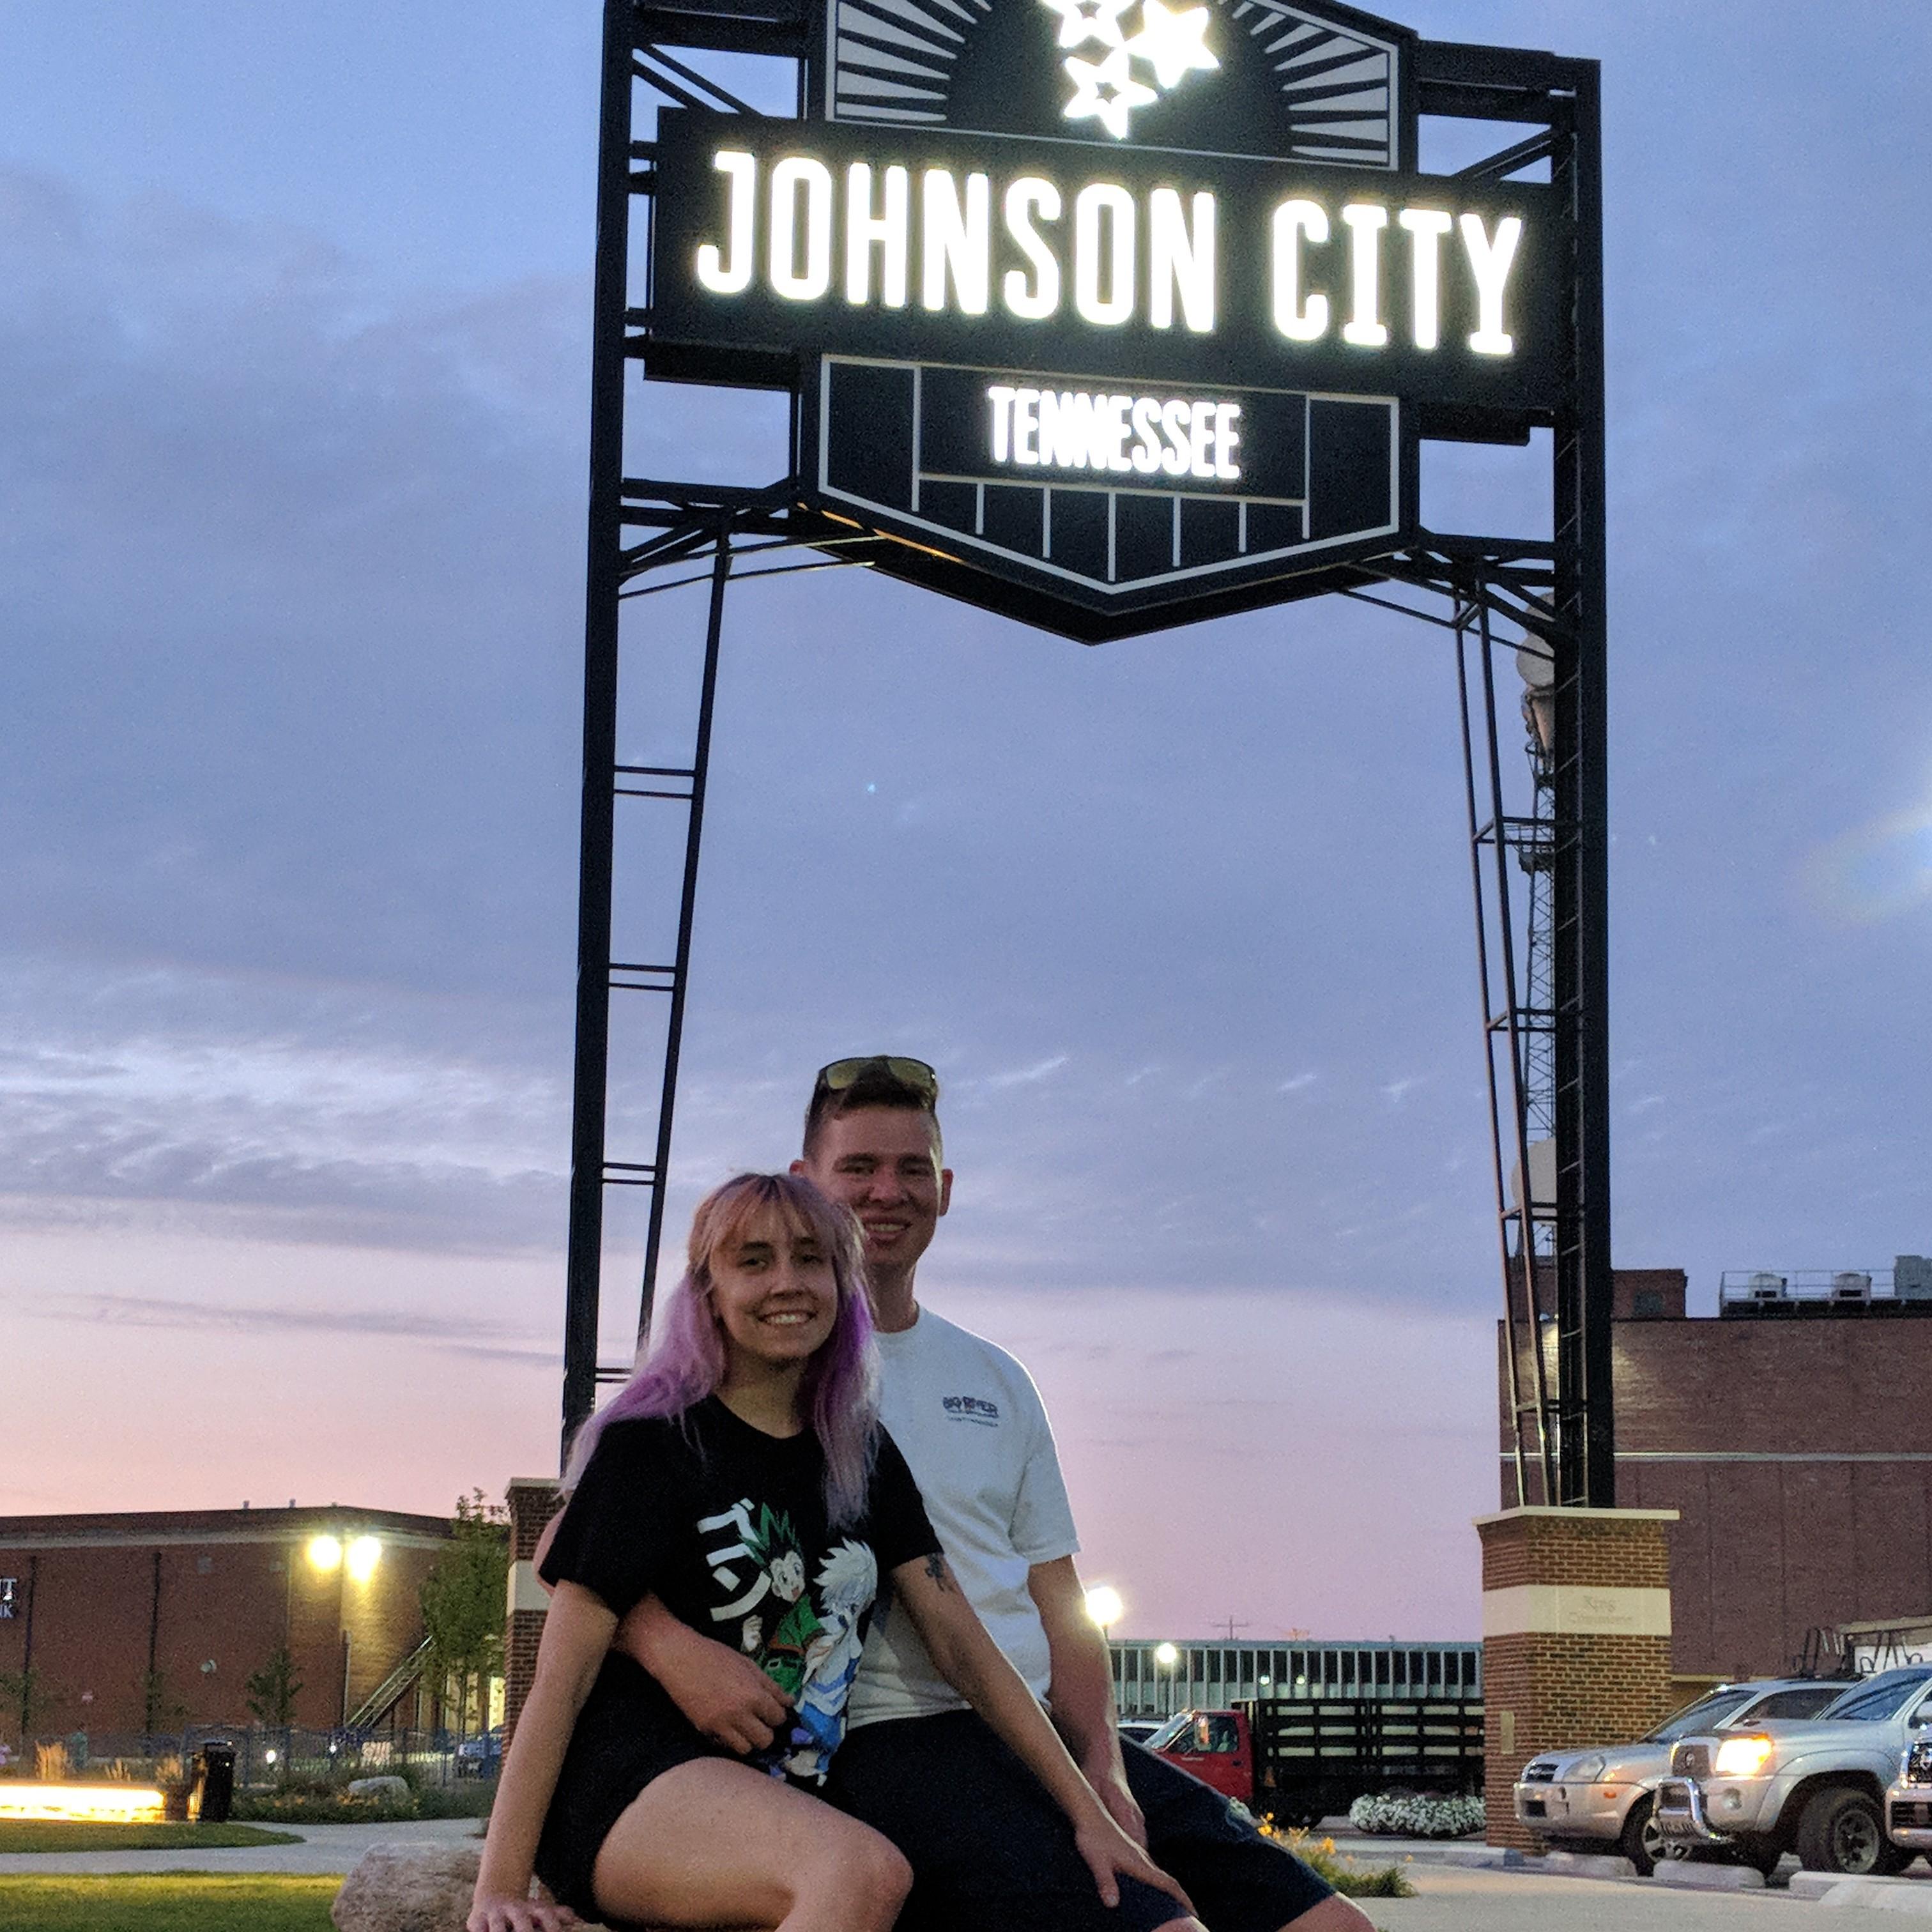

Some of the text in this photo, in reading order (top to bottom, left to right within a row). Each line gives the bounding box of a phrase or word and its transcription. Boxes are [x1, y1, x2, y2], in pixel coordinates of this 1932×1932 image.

[696, 150, 1522, 355] JOHNSON CITY
[988, 386, 1241, 480] TENNESSEE
